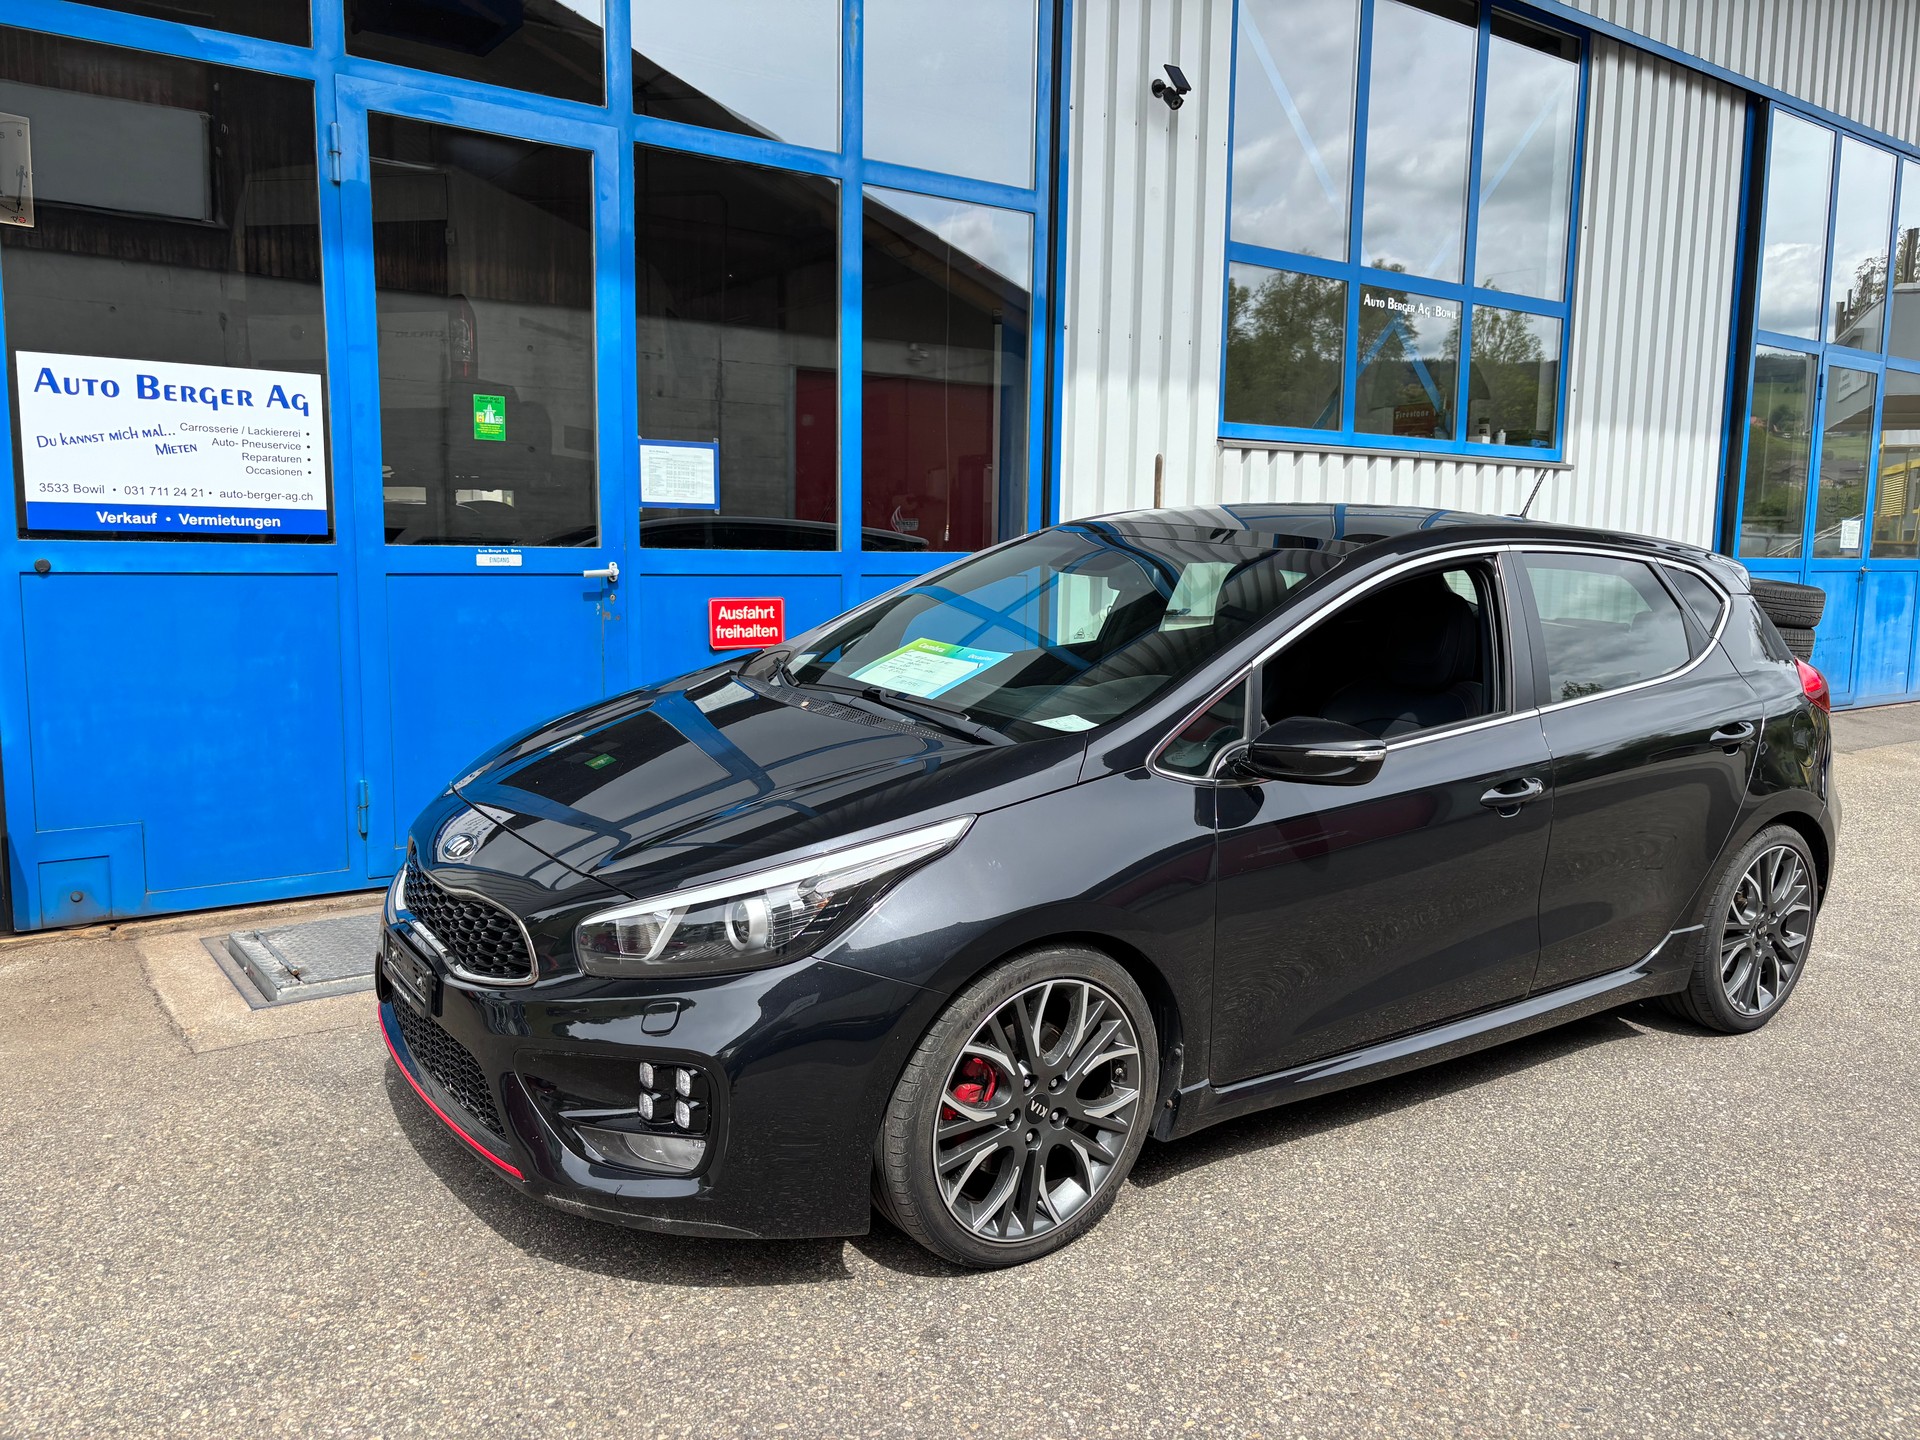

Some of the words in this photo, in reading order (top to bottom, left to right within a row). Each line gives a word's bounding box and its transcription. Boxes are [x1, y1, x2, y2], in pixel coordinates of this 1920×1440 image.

[180, 422, 239, 435] Carrosserie
[248, 427, 301, 438] Lackiererei
[212, 438, 238, 448] Auto-
[242, 439, 301, 450] Pneuservice
[242, 453, 302, 465] Reparaturen
[246, 466, 302, 477] Occasionen
[39, 483, 69, 493] 3533
[73, 484, 105, 494] Bowil
[124, 485, 145, 495] 031
[148, 486, 169, 496] 711
[173, 487, 188, 497] 24
[191, 488, 204, 497] 21
[219, 489, 313, 502] auto-berger-ag.ch
[96, 511, 157, 525] Verkauf
[178, 513, 281, 529] Vermietungen
[718, 605, 775, 620] Ausfahrt
[716, 624, 778, 639] freihalten
[1030, 1099, 1049, 1118] KIA
